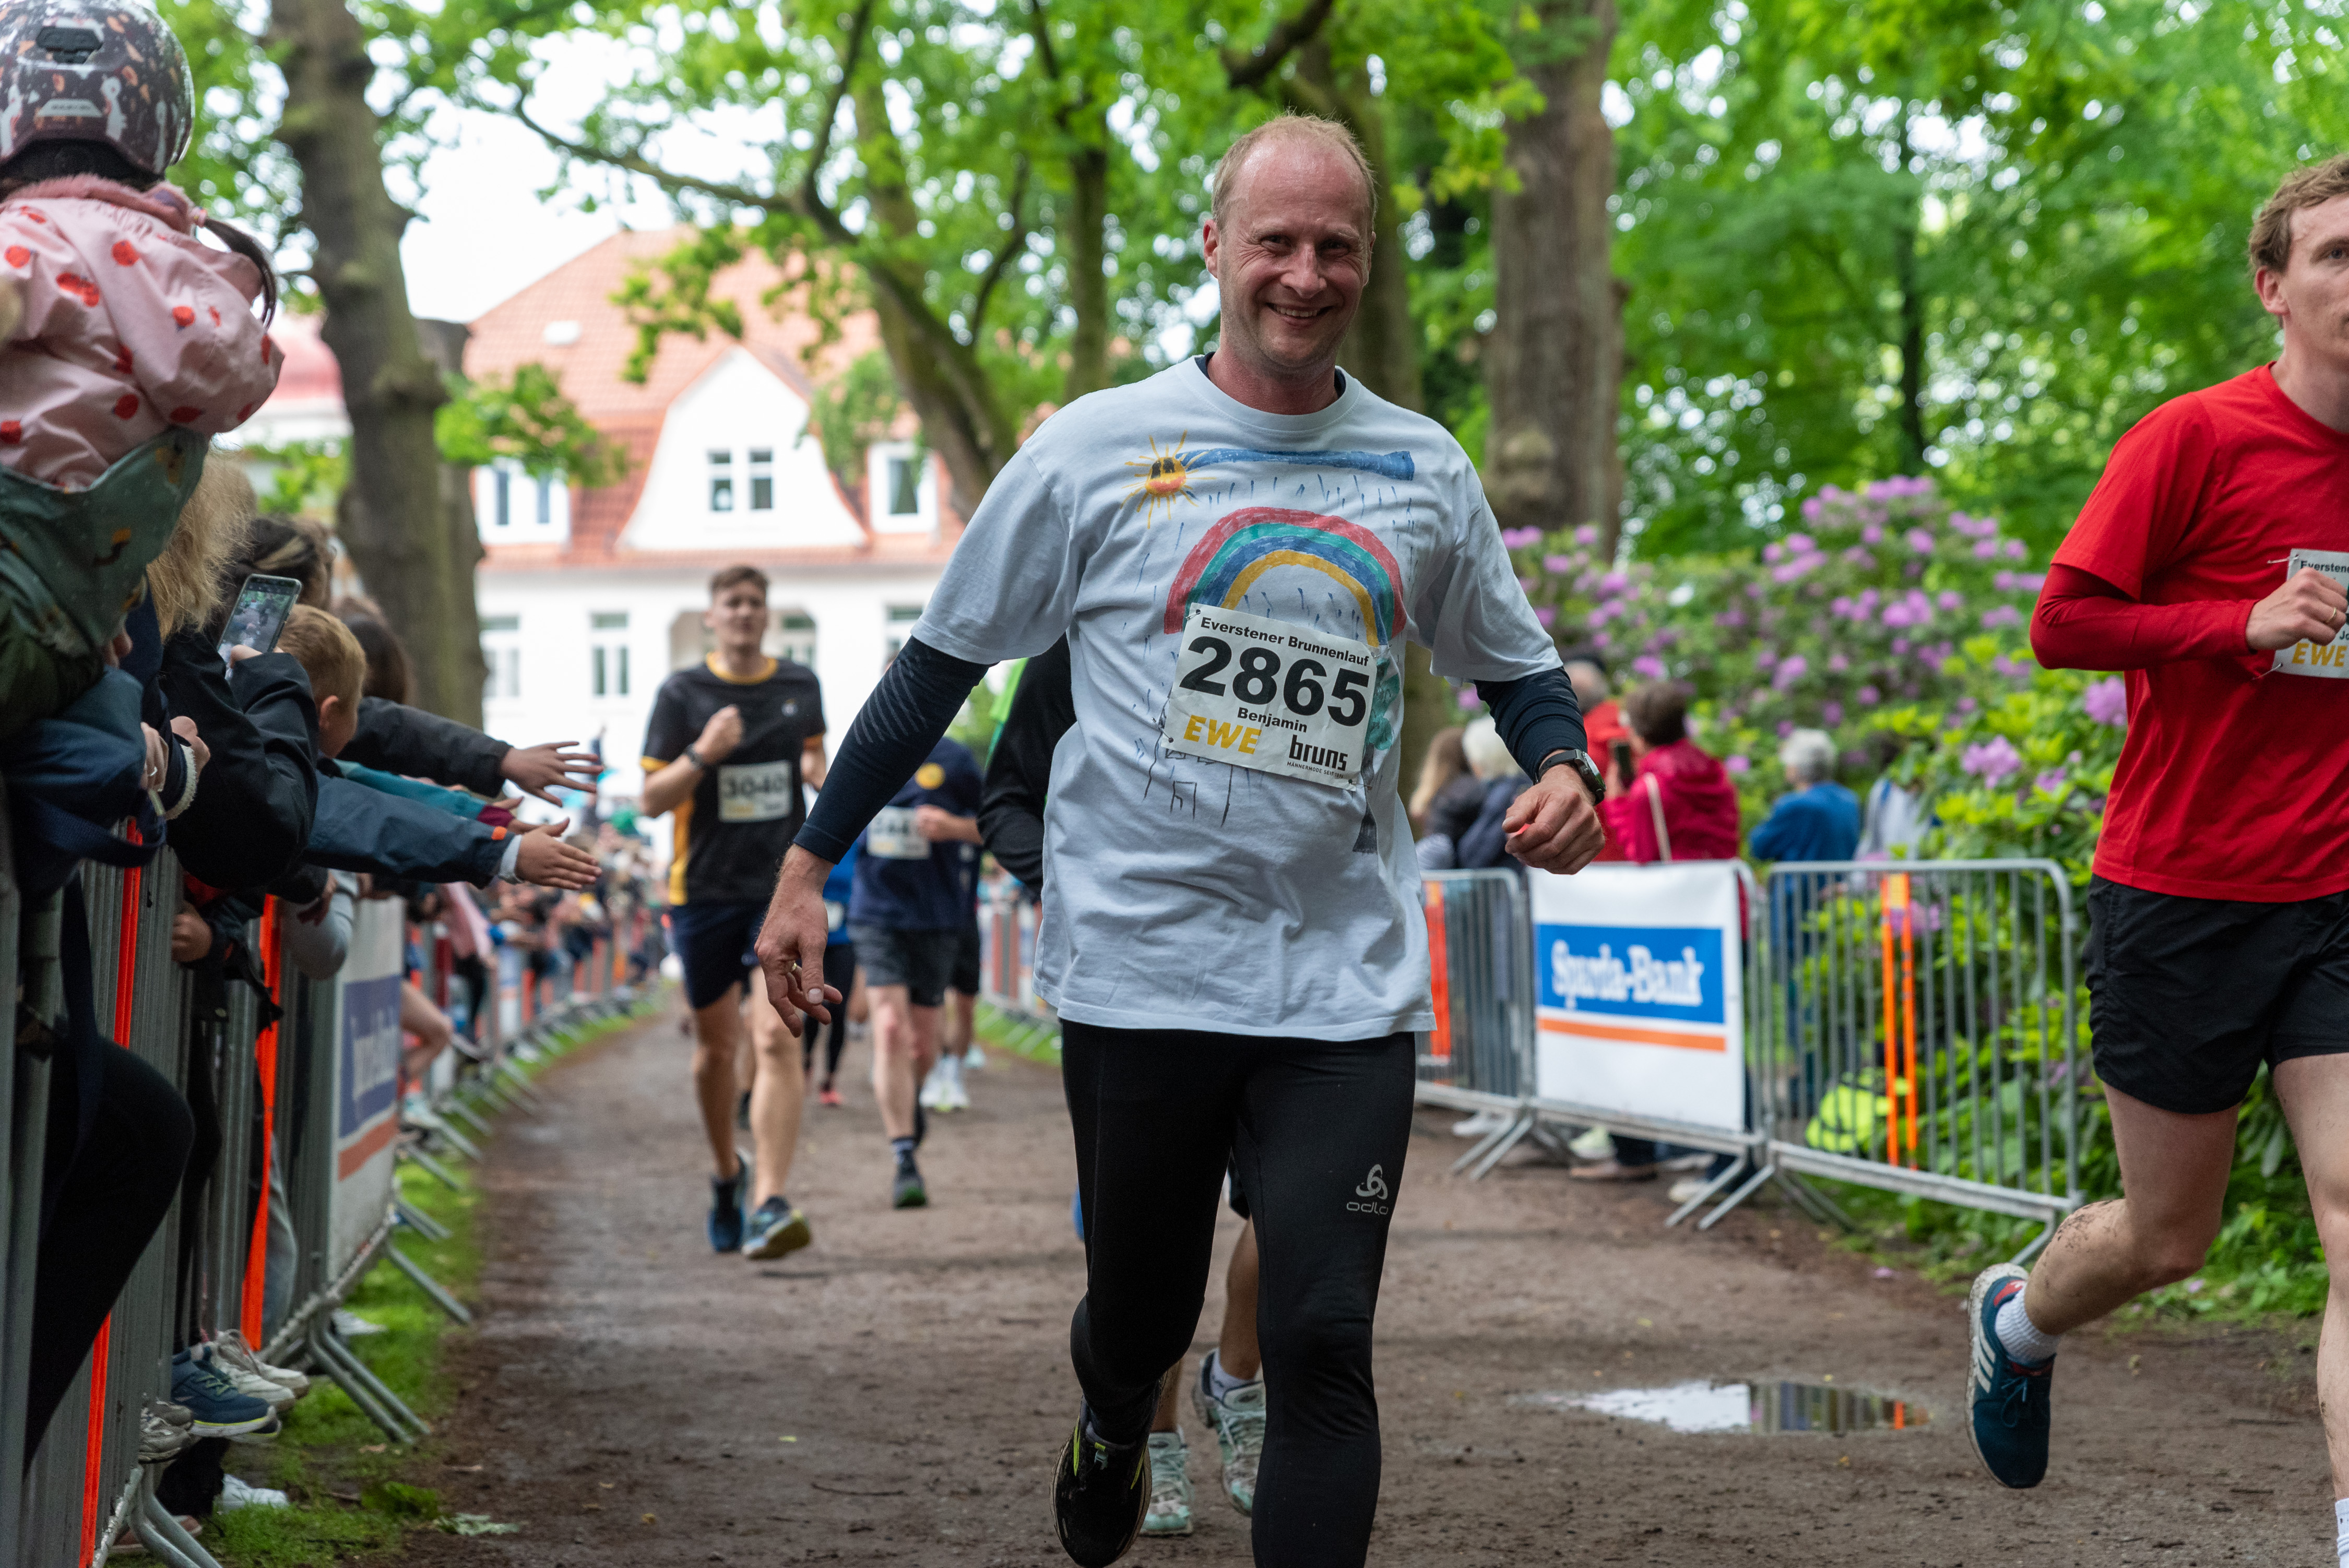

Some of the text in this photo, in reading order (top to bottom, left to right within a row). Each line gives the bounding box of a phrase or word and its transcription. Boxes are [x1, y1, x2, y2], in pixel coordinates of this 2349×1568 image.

[1201, 617, 1370, 667] Everstener Brunnenlauf
[2292, 642, 2347, 668] EWE
[1179, 636, 1370, 727] 2865
[1183, 715, 1262, 754] EWE
[1237, 707, 1308, 733] Benjamin
[1289, 734, 1348, 771] bruns
[1551, 940, 1705, 1011] Sparda-Bank
[1346, 1202, 1389, 1215] odlo
